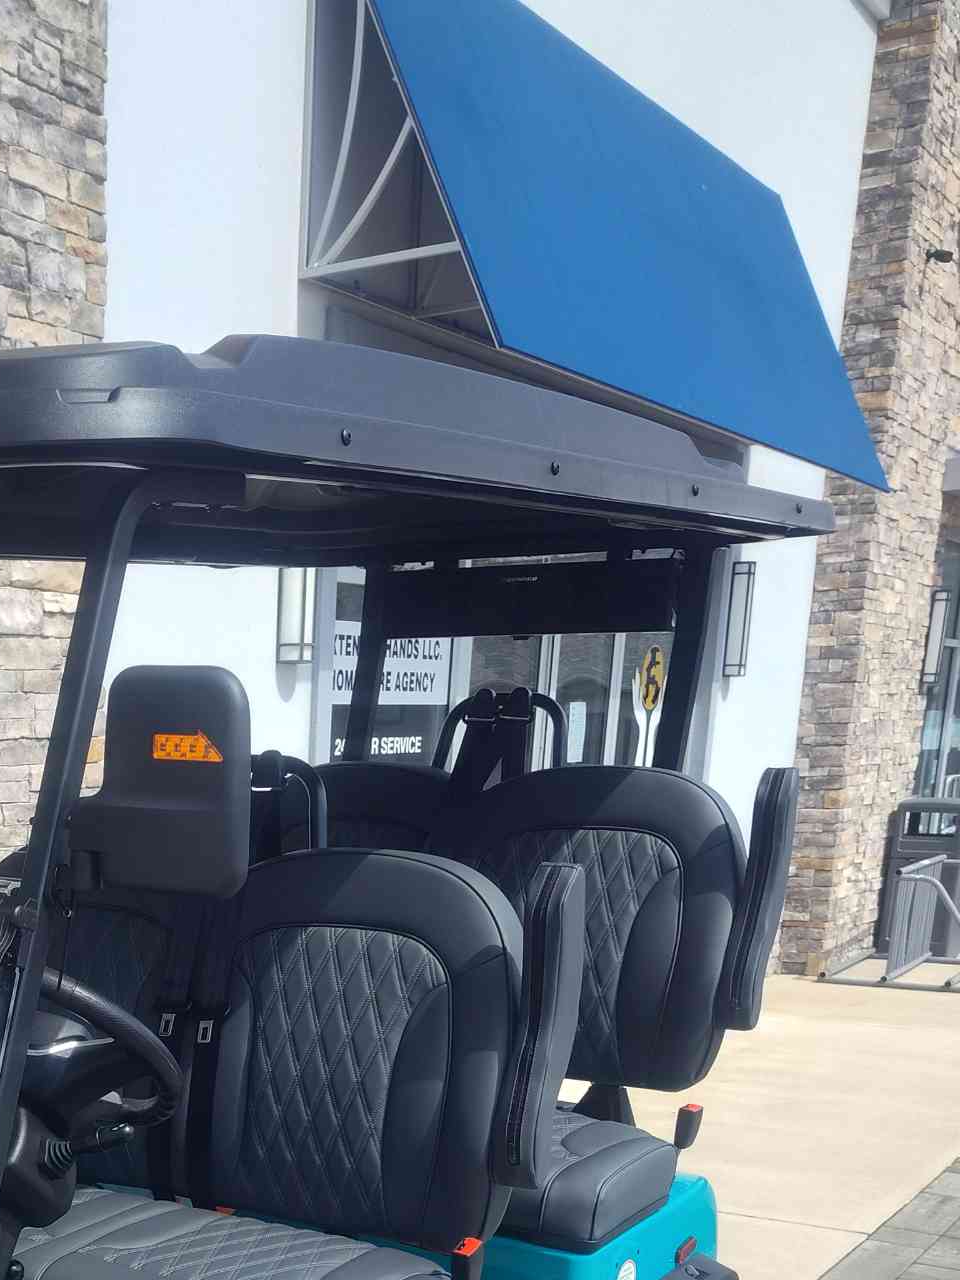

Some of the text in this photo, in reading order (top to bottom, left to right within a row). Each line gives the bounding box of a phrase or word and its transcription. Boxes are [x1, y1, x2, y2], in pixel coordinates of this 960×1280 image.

[385, 638, 419, 660] HANDS
[394, 671, 436, 692] AGENCY
[380, 736, 422, 755] SERVICE
